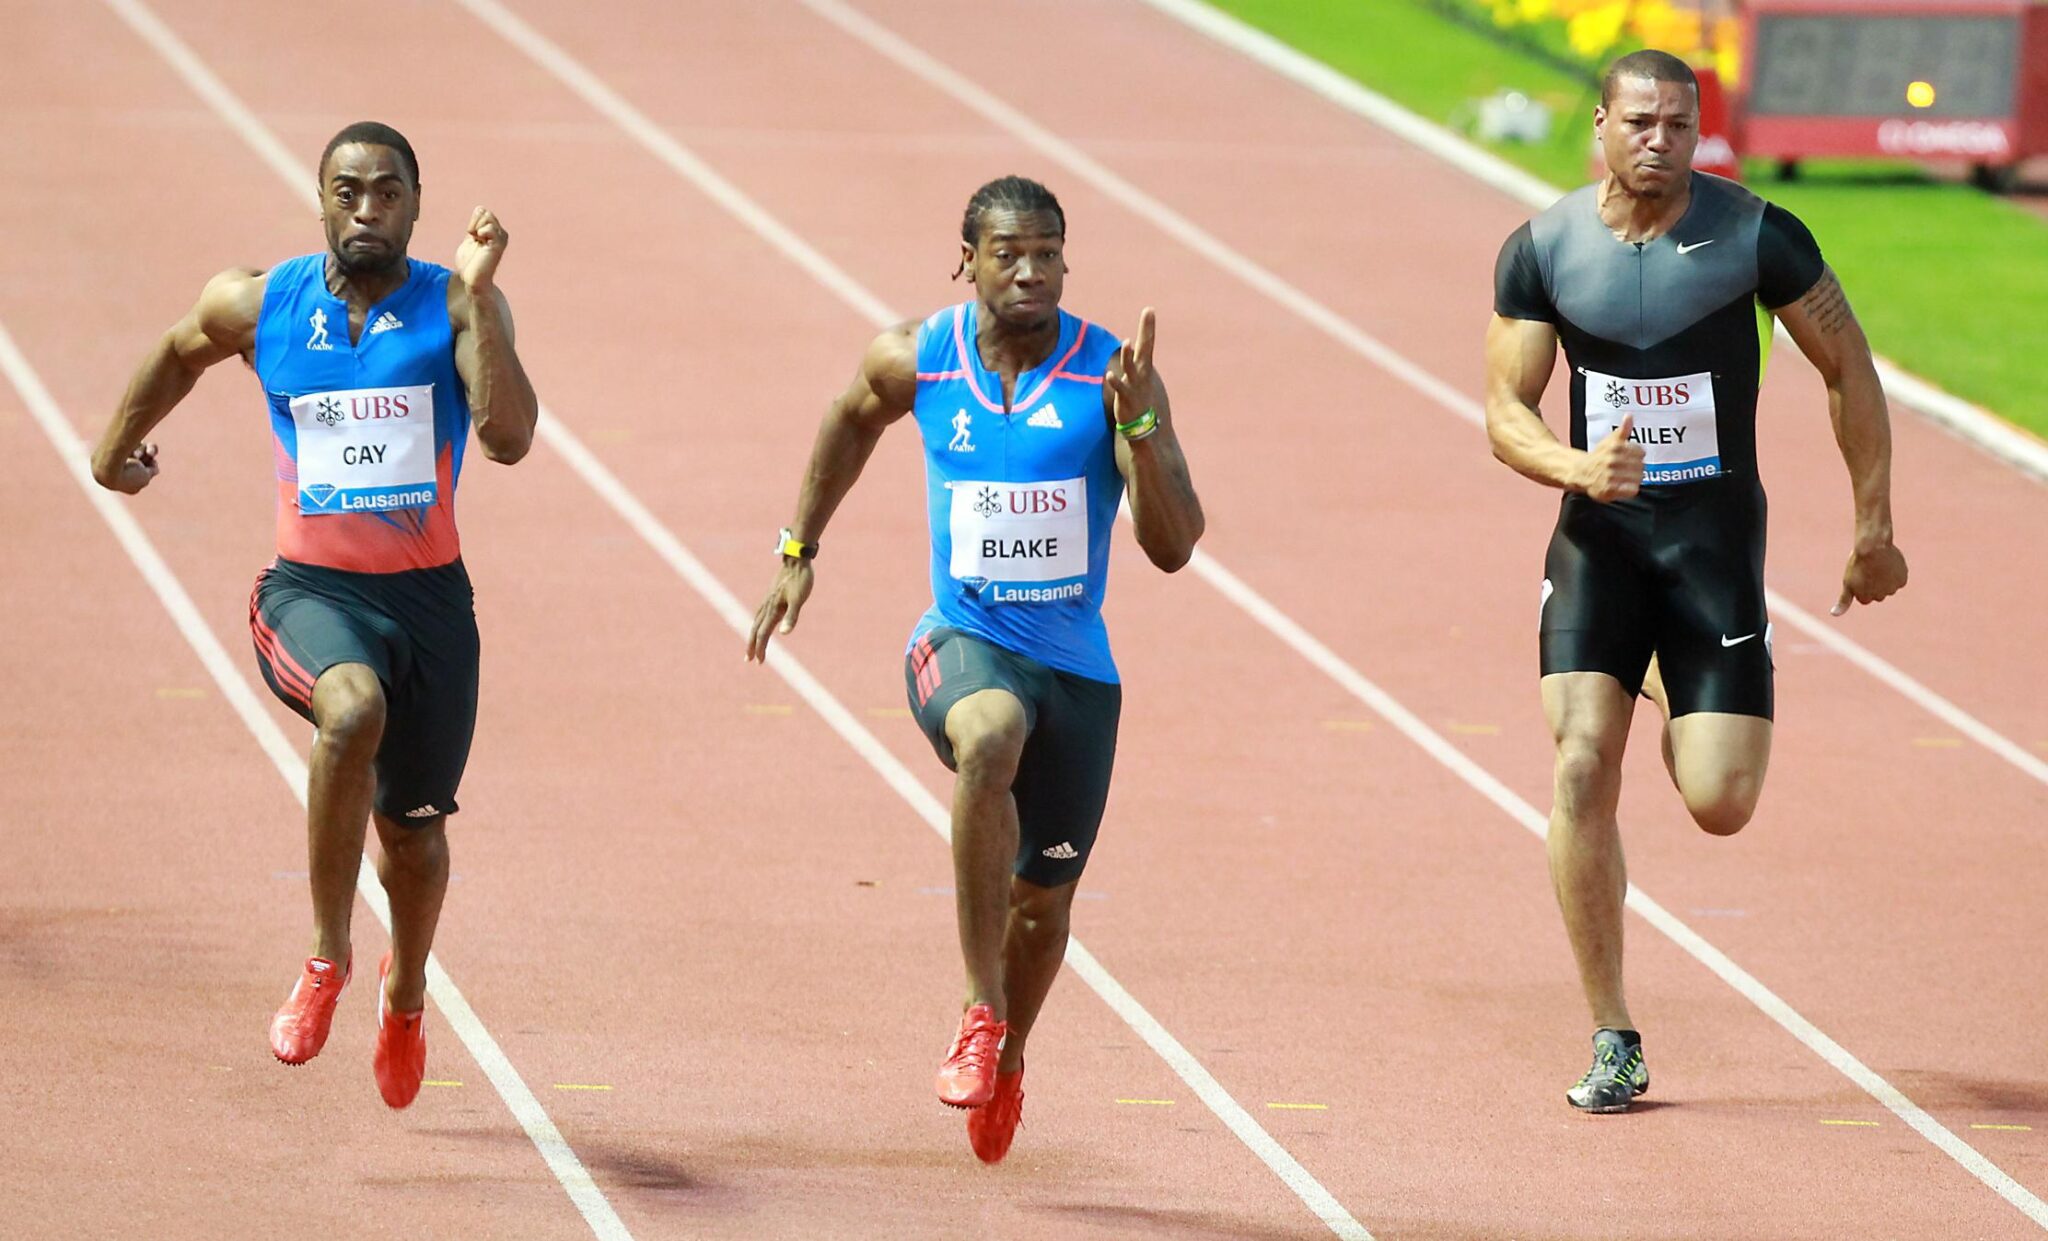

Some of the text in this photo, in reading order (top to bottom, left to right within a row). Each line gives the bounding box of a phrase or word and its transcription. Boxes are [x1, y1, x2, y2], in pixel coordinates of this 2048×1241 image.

[1632, 383, 1690, 406] UBS
[350, 394, 409, 421] UBS
[1612, 425, 1687, 444] AILEY
[342, 444, 388, 465] GAY
[1642, 464, 1717, 482] ausanne
[341, 488, 433, 510] Lausanne
[1008, 488, 1067, 515] UBS
[981, 537, 1059, 559] BLAKE
[993, 582, 1084, 602] Lausanne
